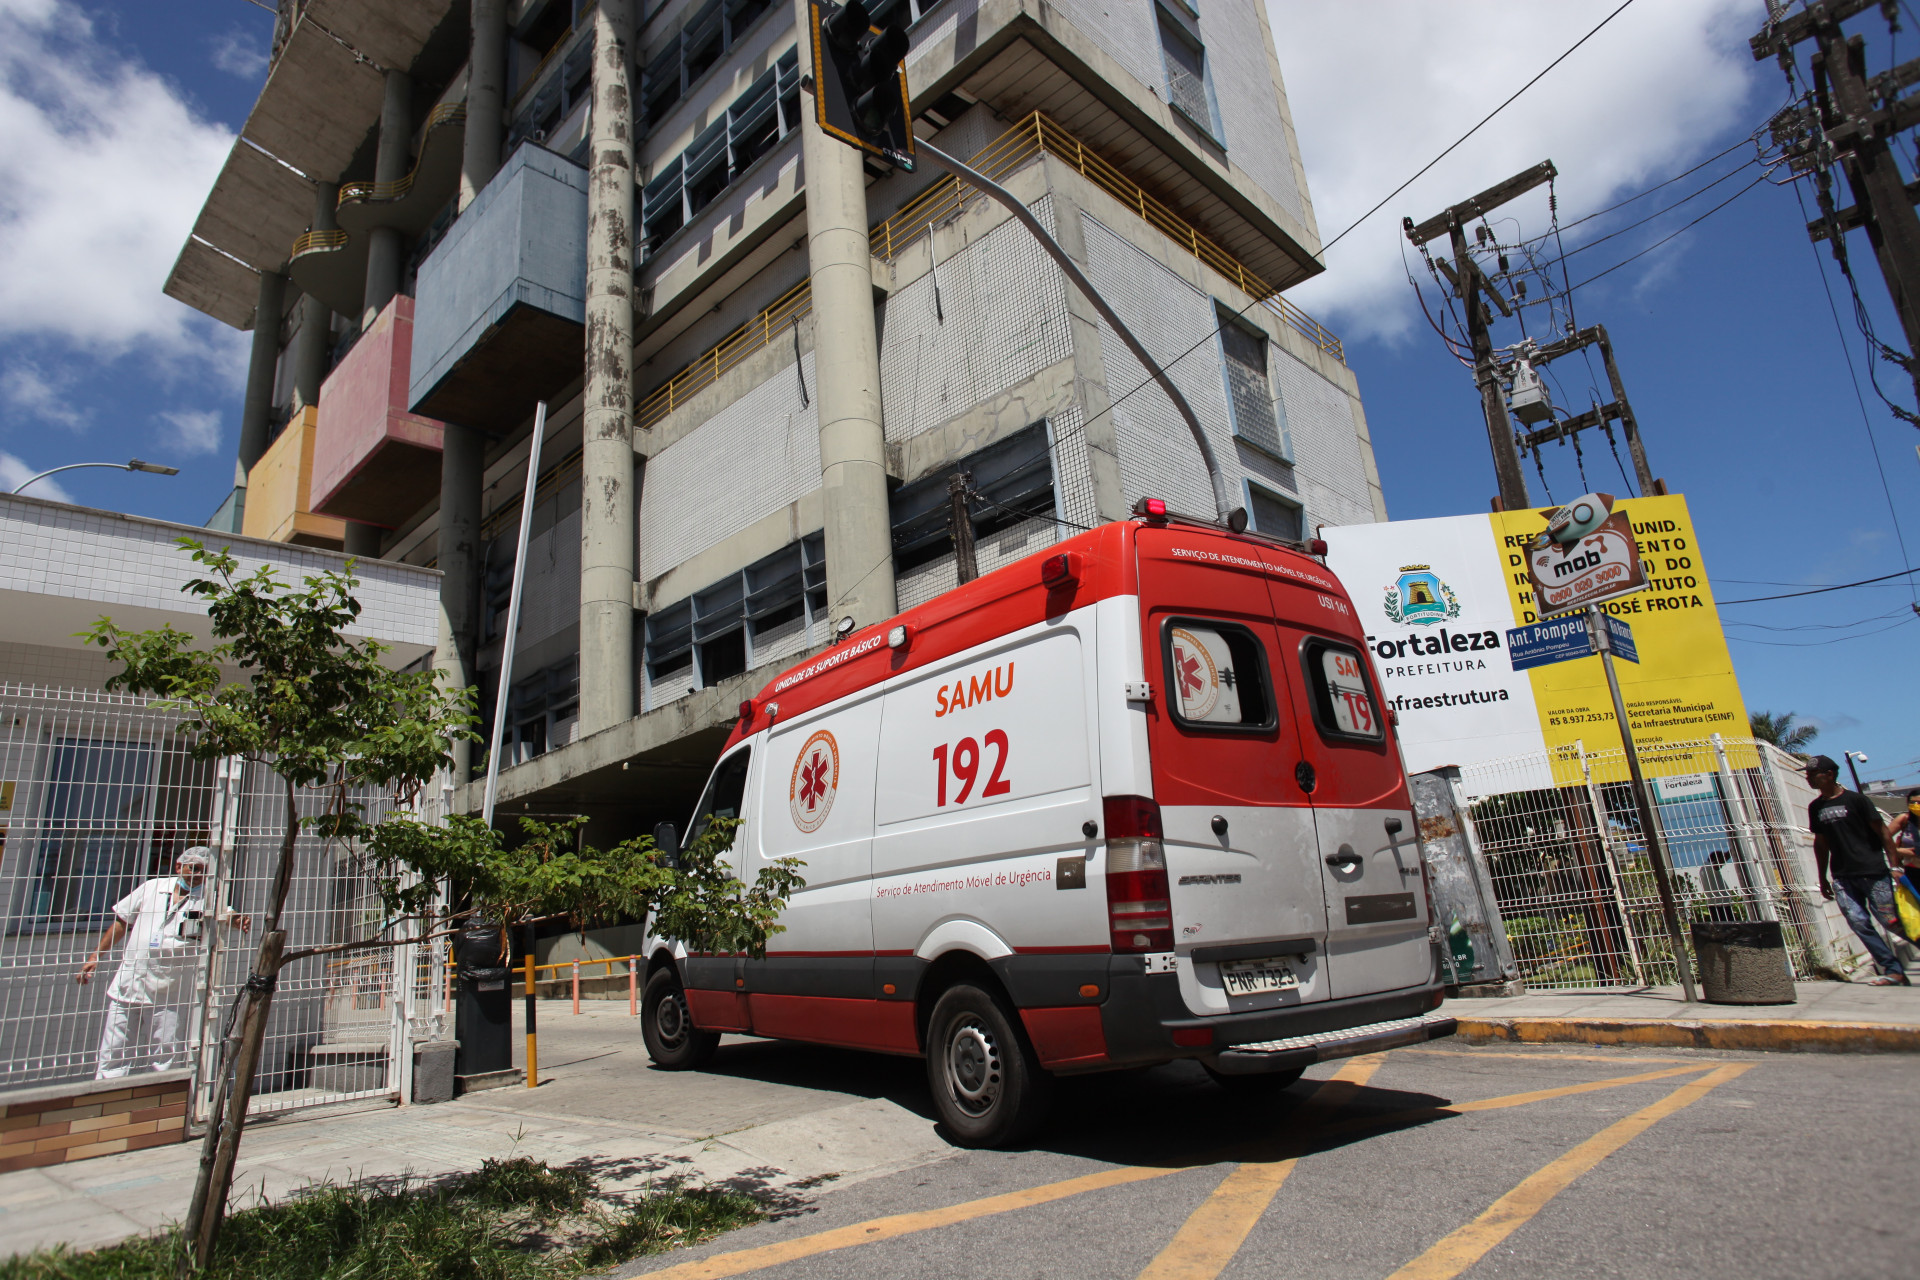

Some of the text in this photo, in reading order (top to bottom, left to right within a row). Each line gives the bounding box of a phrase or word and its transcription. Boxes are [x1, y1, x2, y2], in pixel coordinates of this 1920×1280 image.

[1632, 520, 1682, 534] UNID.
[1171, 548, 1333, 588] SERVIÇO DE ATENDIMENTO MÓVEL DE URGÊNCIA
[1554, 550, 1601, 578] mob
[1665, 557, 1692, 570] DO
[1550, 587, 1572, 604] 0800
[1574, 578, 1593, 593] 020
[1334, 601, 1349, 616] 141
[1600, 598, 1642, 615] JOSÉ
[1646, 595, 1704, 612] FROTA
[1406, 612, 1444, 620] FORTITUDINE
[1509, 619, 1584, 648] Ant. Pompeu
[1524, 646, 1545, 655] Antônio
[1546, 642, 1570, 650] Pompeu
[774, 635, 882, 692] UNIDADE DE SUPORTE BÁSICO
[1386, 659, 1486, 678] PREFEITURA
[935, 662, 1014, 718] SAMU
[1388, 688, 1508, 711] nfraestrutura
[1626, 697, 1682, 708] ÓRGÃO RESPONSÁVEL
[1343, 692, 1372, 732] 19
[1562, 712, 1614, 724] 8.937.253,73
[1628, 702, 1714, 718] Secretaria Municipal
[1632, 712, 1735, 729] da Infraestrutura (SEINF)
[1636, 735, 1662, 744] EXECUÇÃO
[932, 728, 1010, 808] 192
[1640, 754, 1673, 764] Serviços
[1665, 778, 1702, 789] Fortaleza
[876, 866, 1051, 899] Serviço de Atendimento Móvel de Urgência
